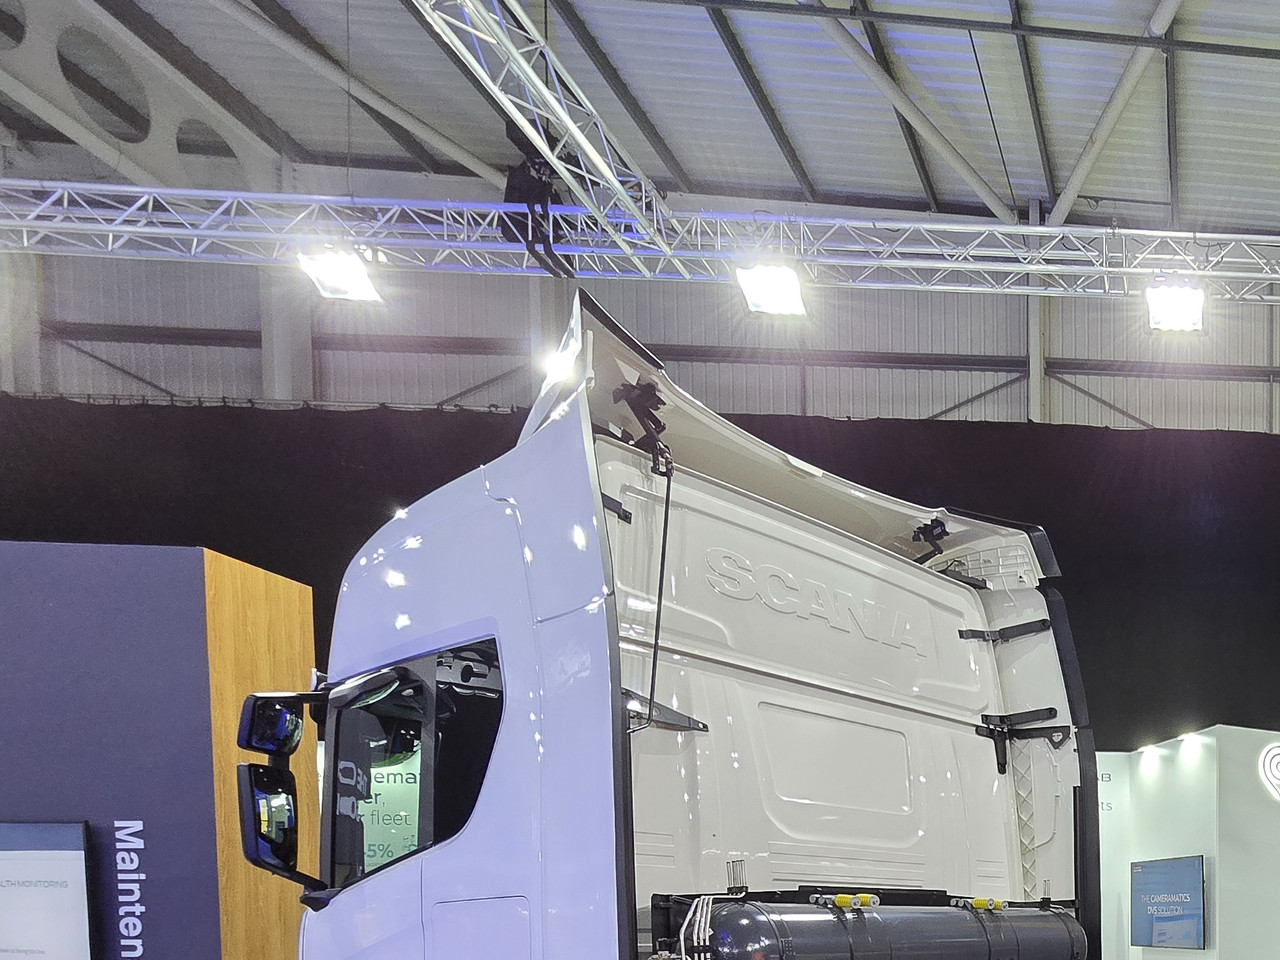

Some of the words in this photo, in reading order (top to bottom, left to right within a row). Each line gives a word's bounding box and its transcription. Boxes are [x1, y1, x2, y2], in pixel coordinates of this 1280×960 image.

[704, 546, 928, 659] SCANIA
[371, 809, 412, 826] fleet
[364, 843, 394, 859] 5%
